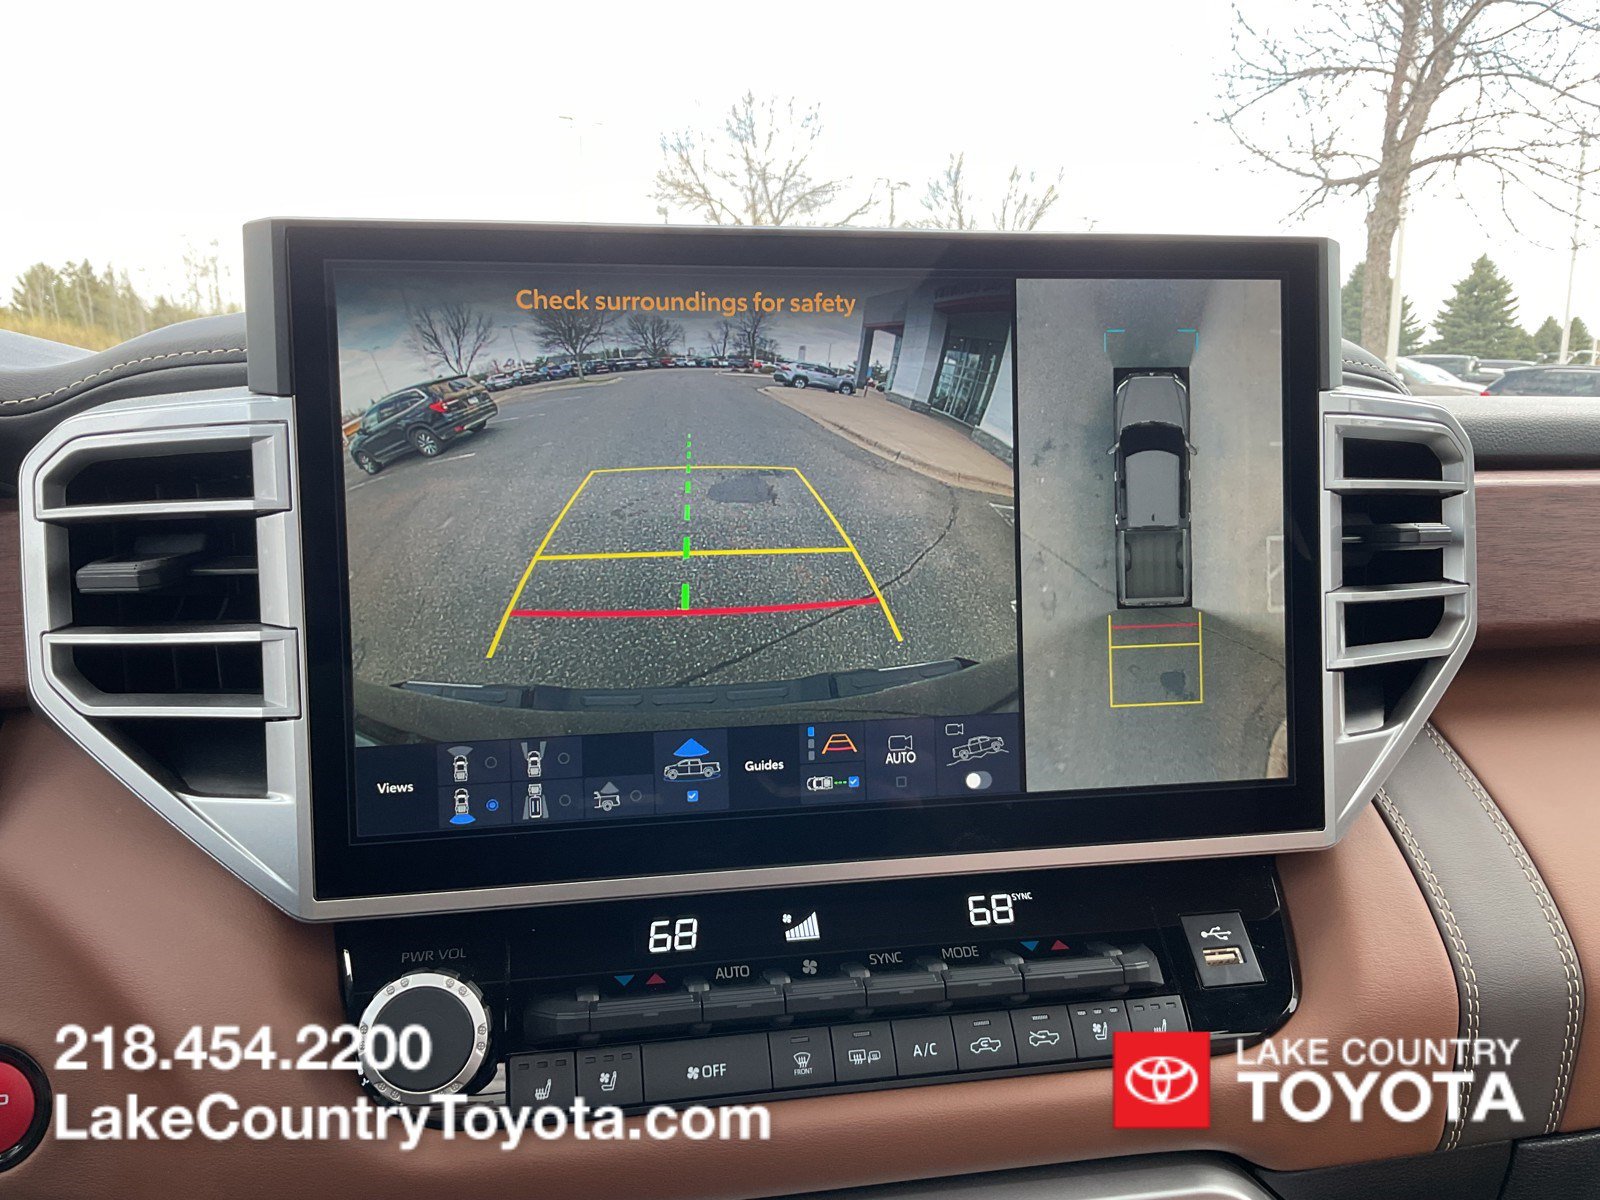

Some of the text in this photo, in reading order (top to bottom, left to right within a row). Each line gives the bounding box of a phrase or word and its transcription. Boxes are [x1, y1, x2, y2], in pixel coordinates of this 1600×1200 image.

[516, 288, 856, 317] Check surroundings for safety
[885, 750, 917, 765] AUTO
[744, 758, 784, 774] Guides
[376, 780, 414, 796] Views
[1011, 891, 1033, 902] SYNC
[968, 893, 1014, 927] 68
[648, 917, 698, 953] 68
[401, 947, 467, 964] PWR VOL
[868, 951, 903, 966] SYNC
[941, 945, 979, 960] MODE
[715, 964, 751, 981] AUTO
[913, 1041, 938, 1058] A/C
[702, 1063, 727, 1079] OFF
[793, 1067, 813, 1076] FRONT
